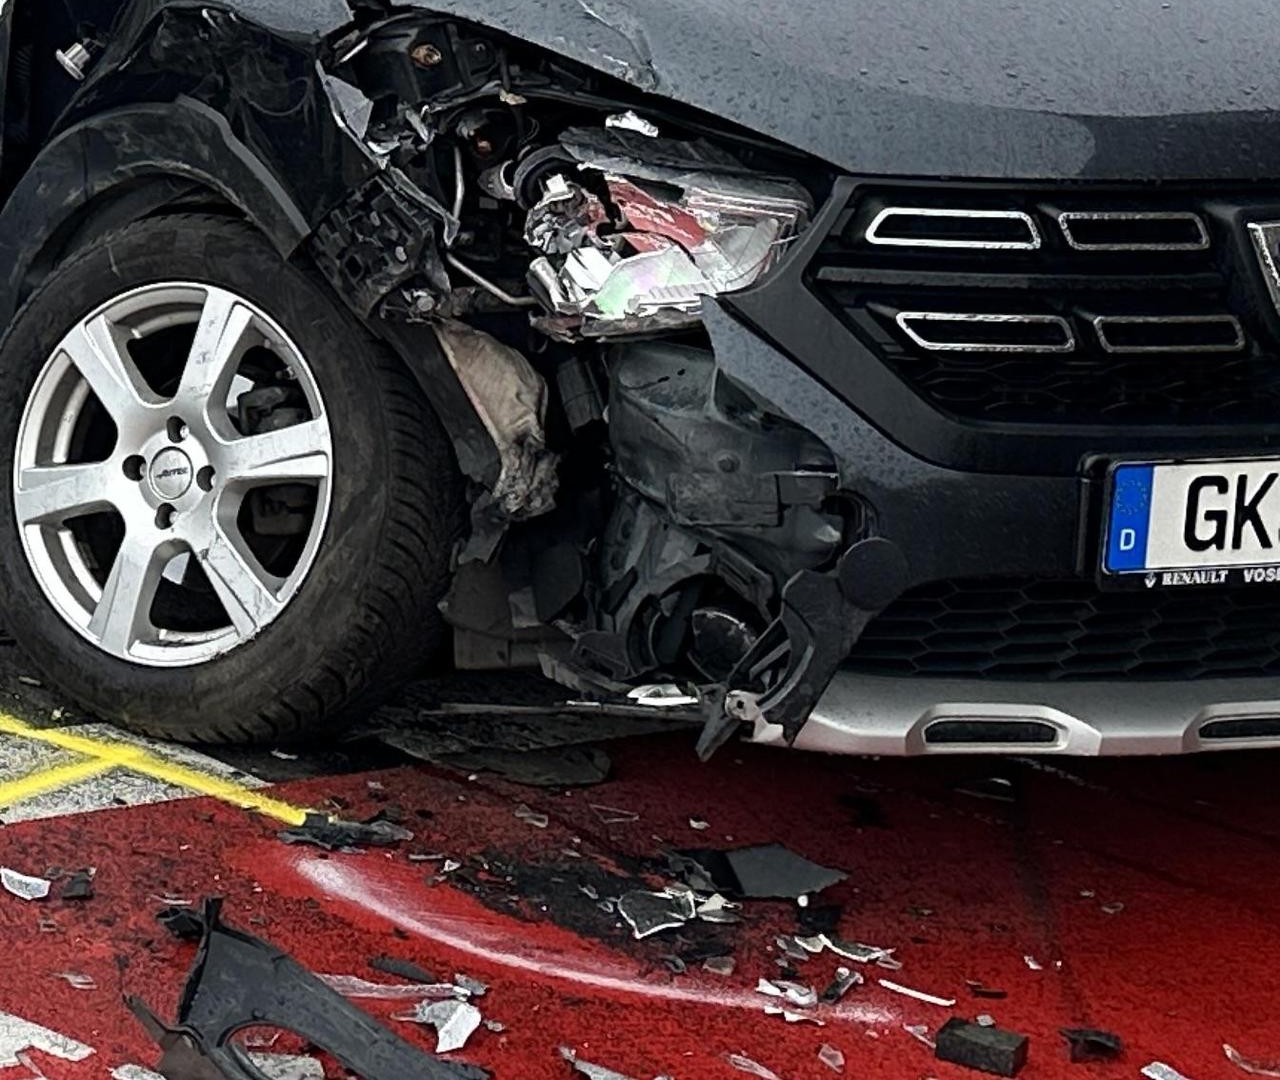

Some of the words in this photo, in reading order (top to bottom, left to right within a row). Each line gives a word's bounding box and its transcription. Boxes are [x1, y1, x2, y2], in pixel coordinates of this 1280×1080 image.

[1184, 472, 1279, 552] GK
[1119, 528, 1136, 551] D
[1161, 570, 1229, 586] RENAULT
